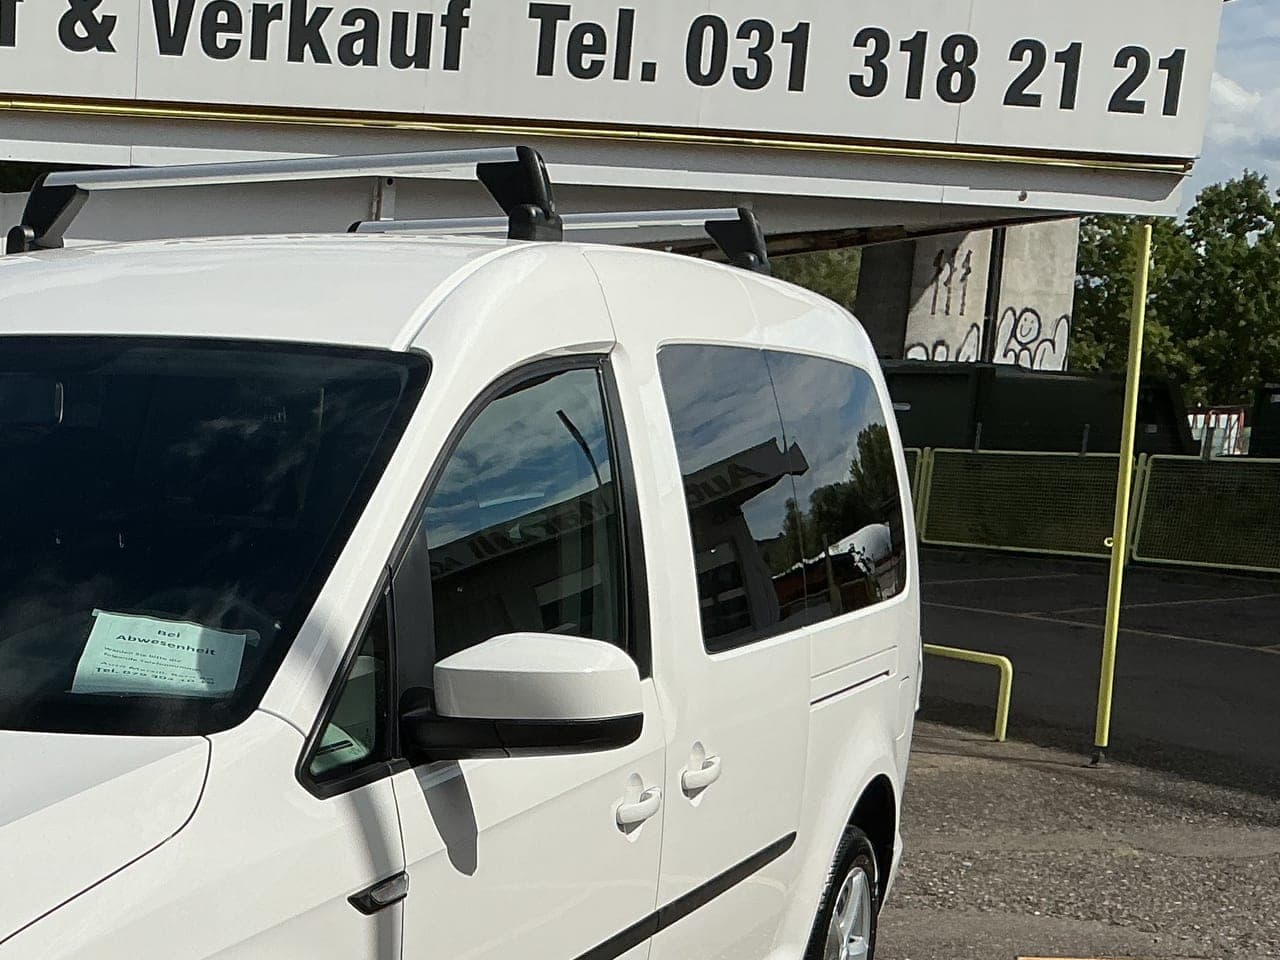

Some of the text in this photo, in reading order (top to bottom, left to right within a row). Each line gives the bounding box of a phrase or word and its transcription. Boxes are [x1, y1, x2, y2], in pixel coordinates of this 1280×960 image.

[59, 0, 118, 53] &
[151, 0, 471, 72] Verkauf
[528, 2, 657, 82] Tel.
[685, 14, 810, 92] 031
[848, 27, 978, 104] 318
[1002, 38, 1082, 110] 21
[1107, 45, 1186, 117] 21
[115, 634, 217, 656] Abwesenheit
[157, 629, 181, 639] Bei
